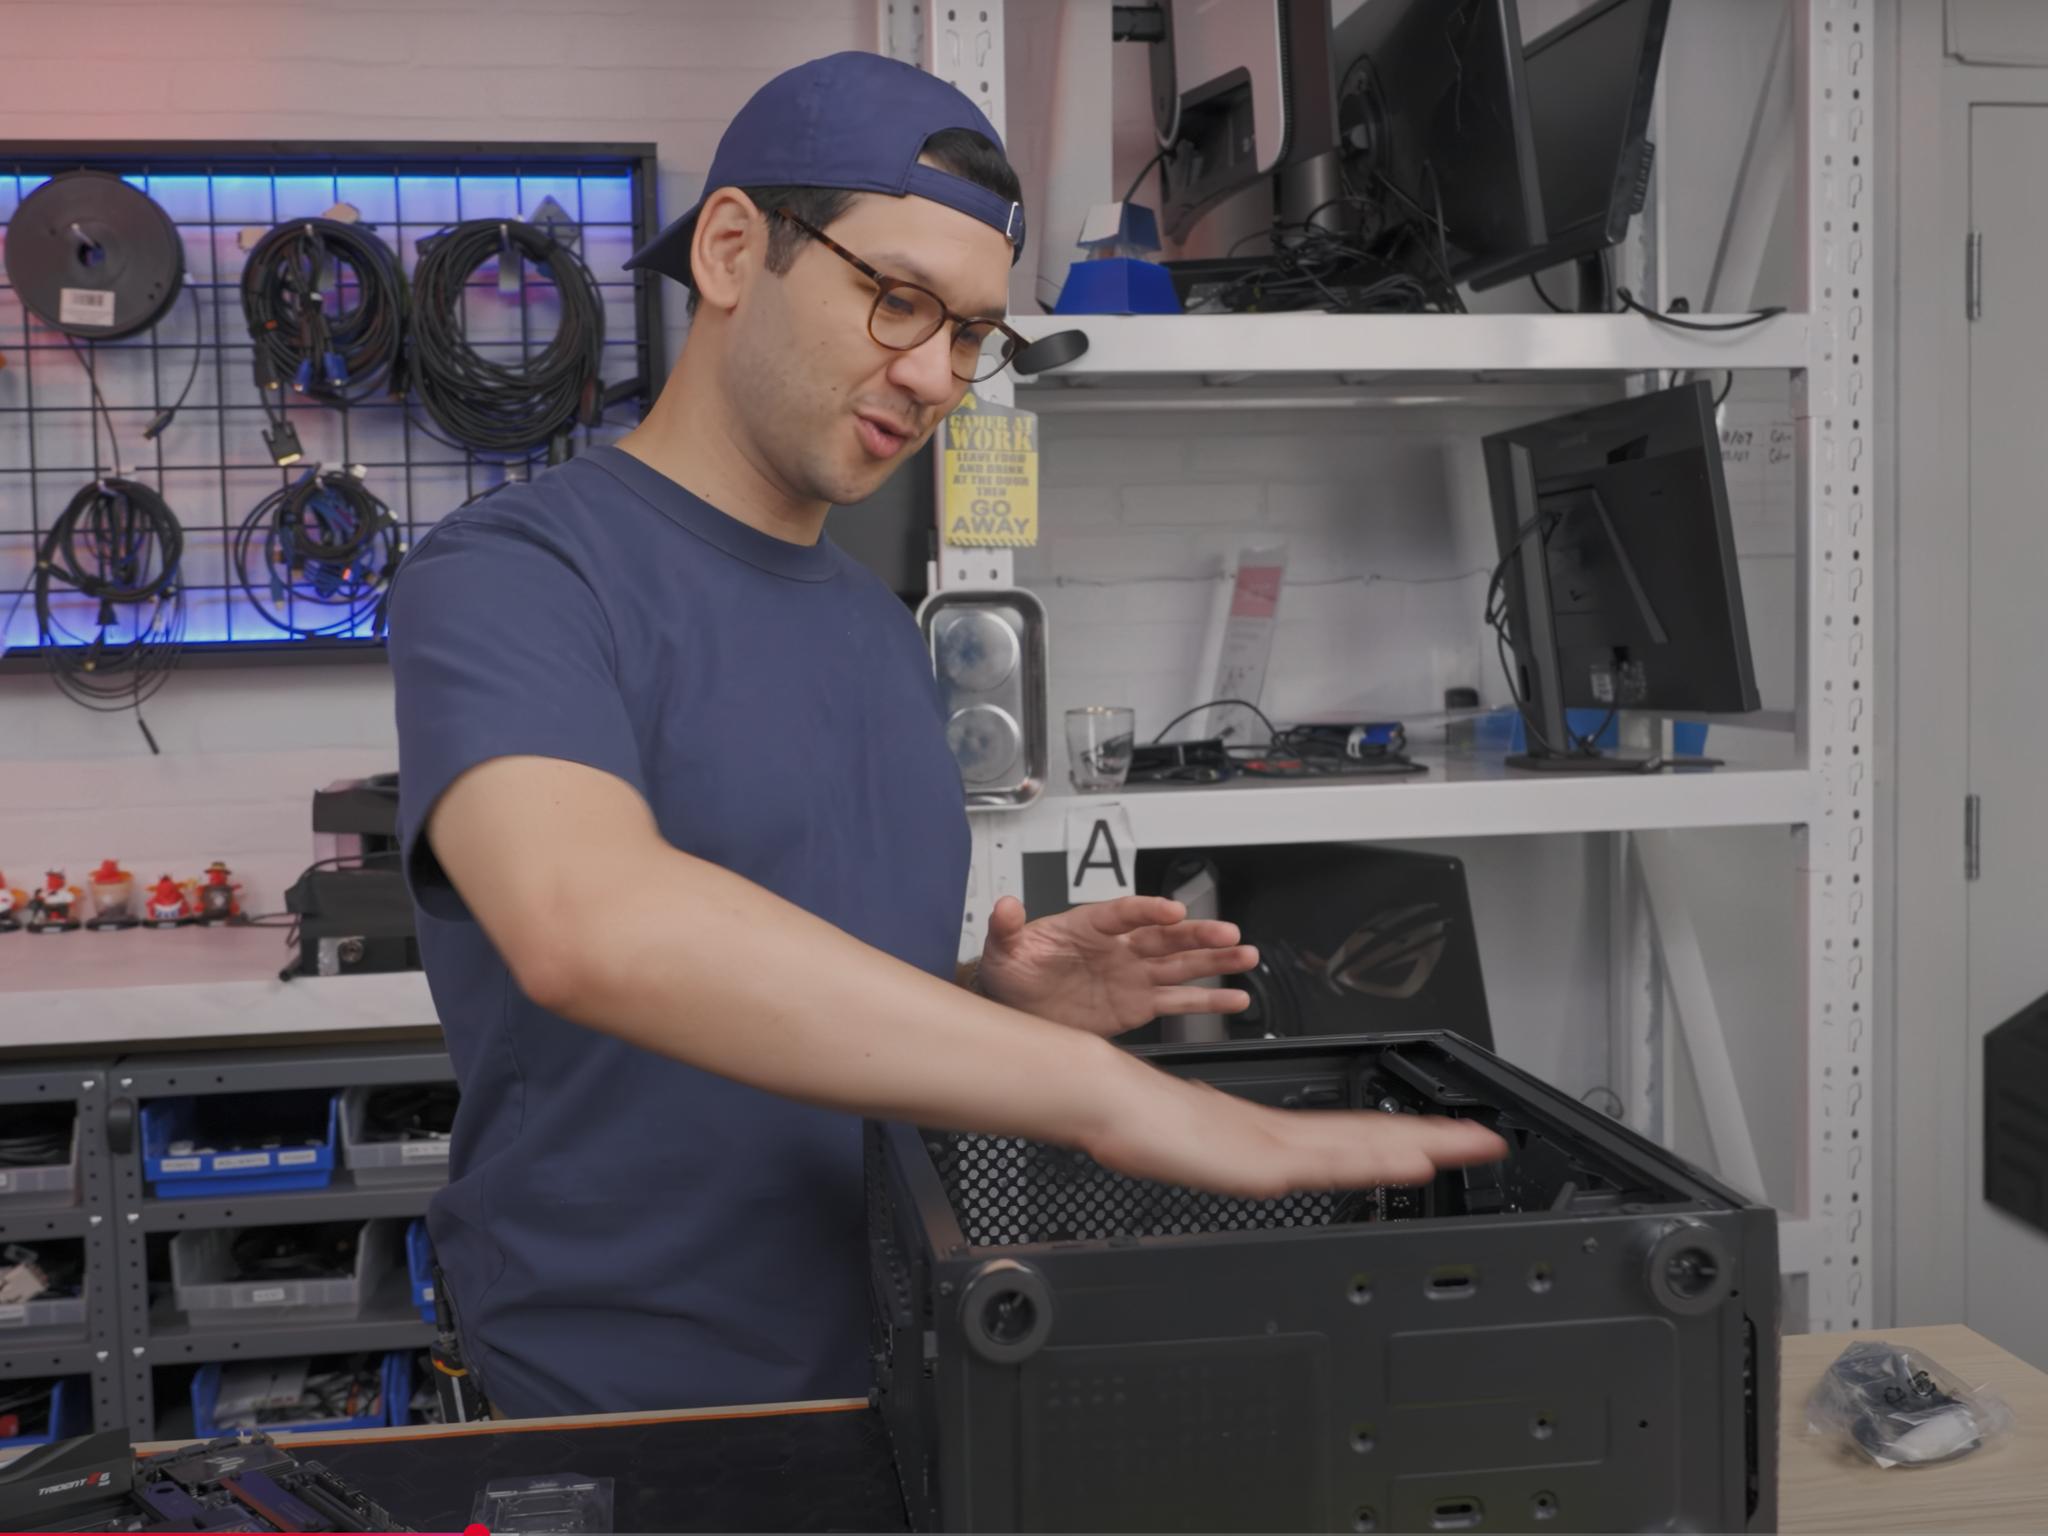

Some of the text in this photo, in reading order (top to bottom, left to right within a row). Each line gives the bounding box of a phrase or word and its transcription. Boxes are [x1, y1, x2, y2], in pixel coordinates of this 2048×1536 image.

[950, 428, 1033, 450] WORK
[957, 453, 991, 462] LEAVE
[959, 463, 1024, 474] AND DRINK
[953, 475, 967, 484] AT
[971, 475, 992, 485] THE
[976, 487, 1007, 496] THEN
[971, 499, 1011, 517] GO
[952, 517, 1030, 534] AWAY
[1073, 819, 1127, 887] A
